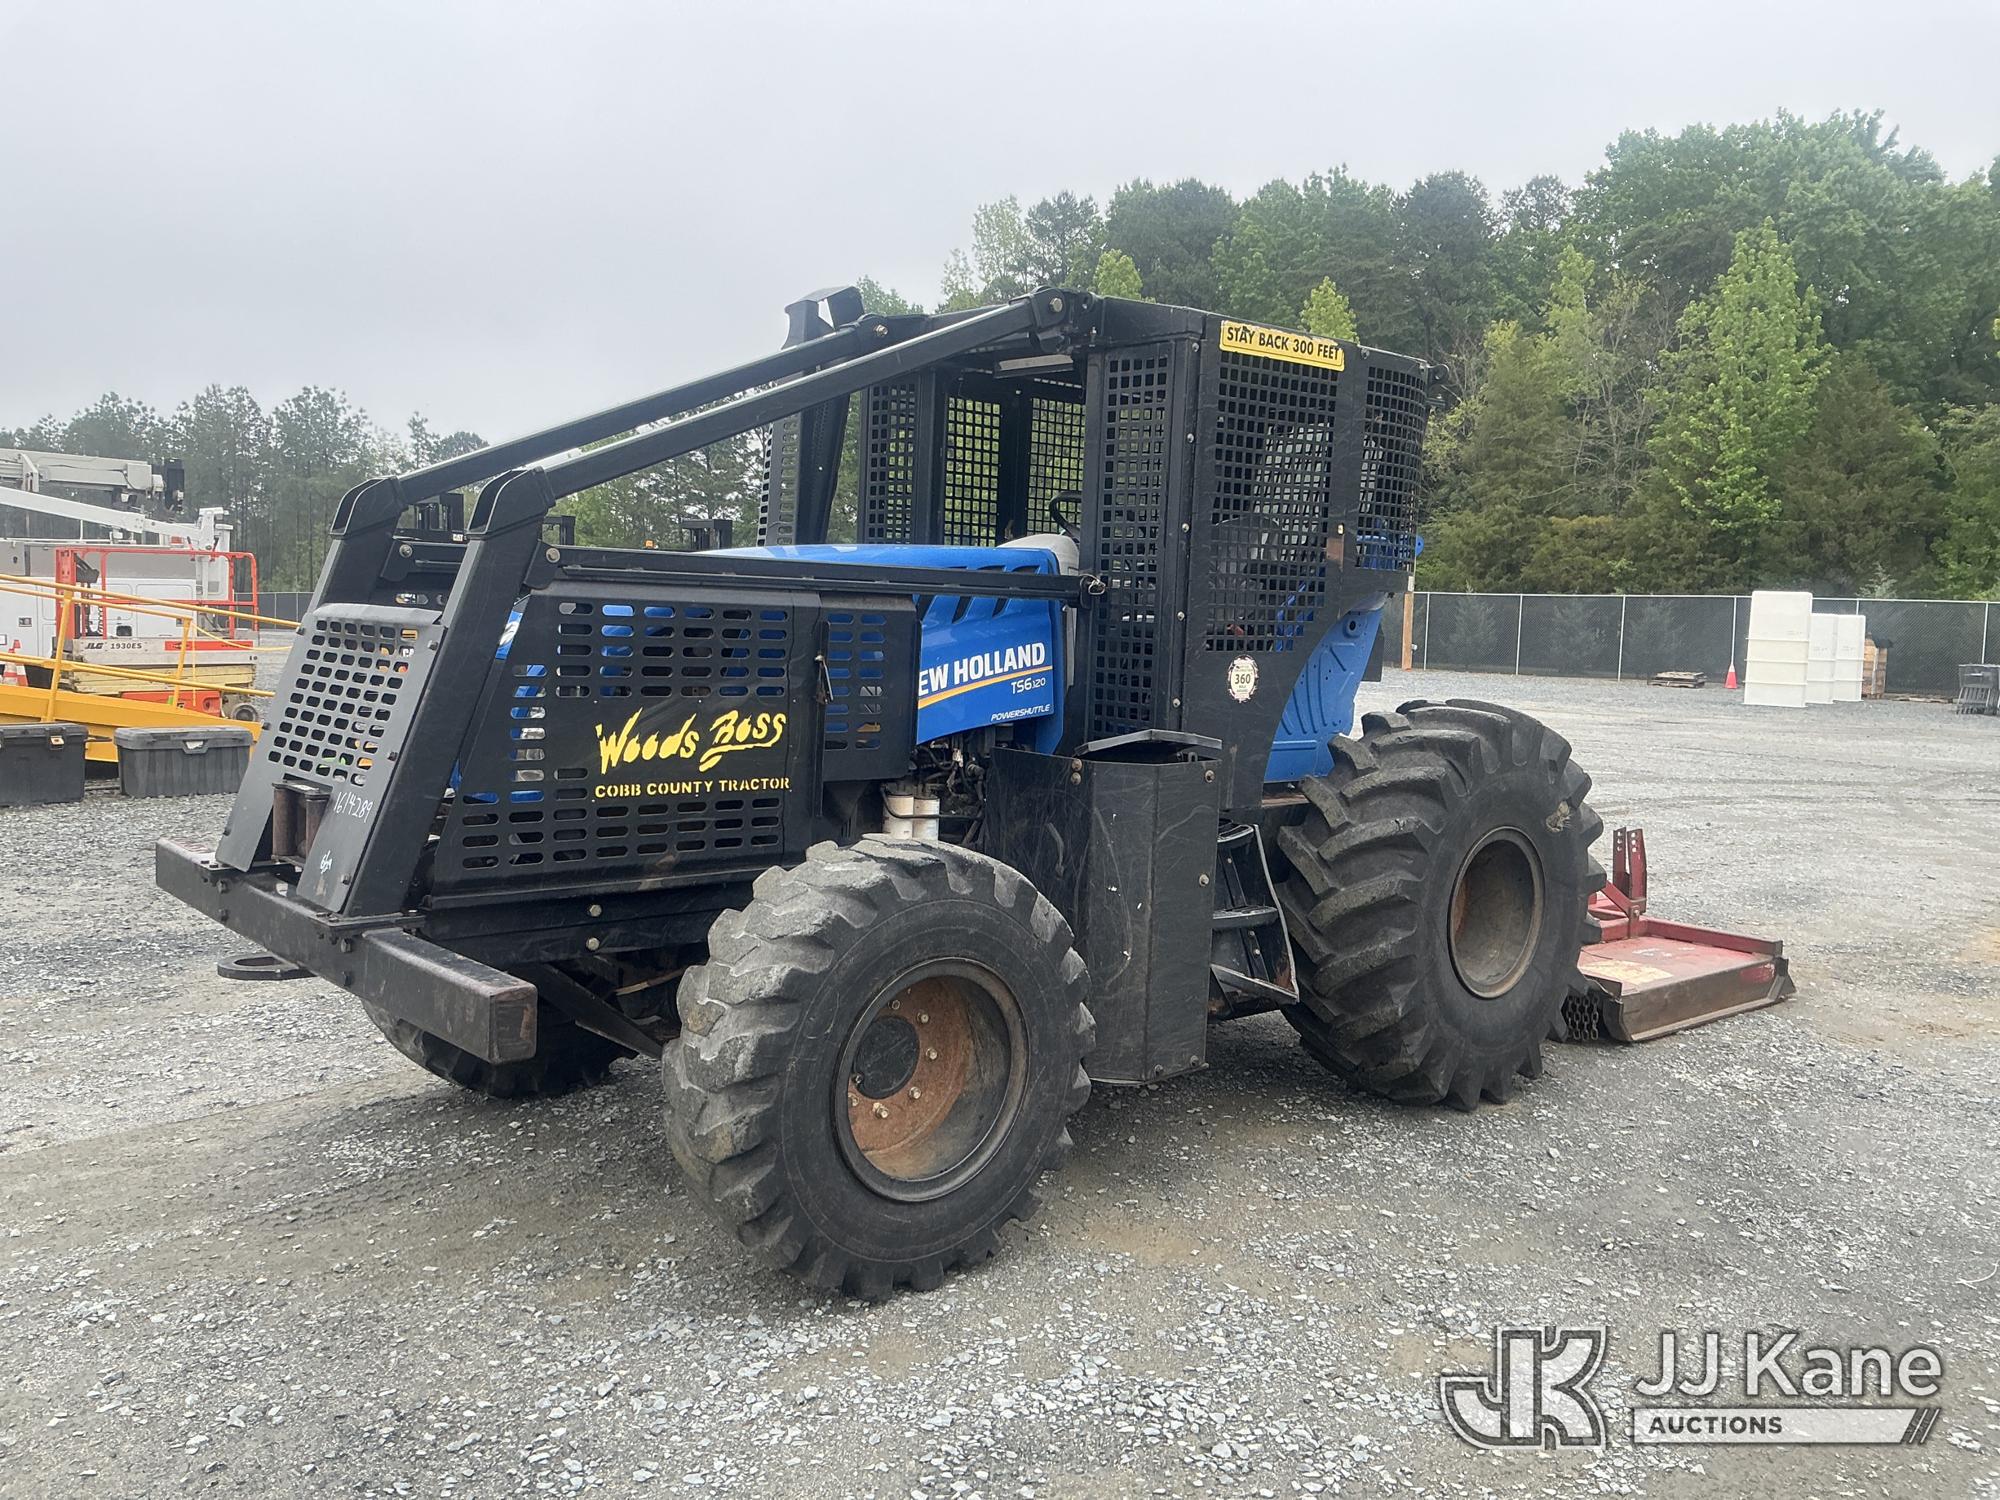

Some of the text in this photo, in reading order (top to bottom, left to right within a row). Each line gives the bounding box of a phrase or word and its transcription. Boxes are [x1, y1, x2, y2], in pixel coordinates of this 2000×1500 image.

[1227, 325, 1339, 360] STAY BACK 300 FEET
[110, 642, 142, 650] 1930ES
[918, 642, 1046, 696] EW HOLLAND
[1234, 673, 1251, 685] 360
[991, 704, 1051, 722] POWERSHUTTLE
[595, 707, 700, 775] Woods
[594, 777, 791, 799] COBB COUNTY TRACTOR
[333, 791, 373, 823] 1614289
